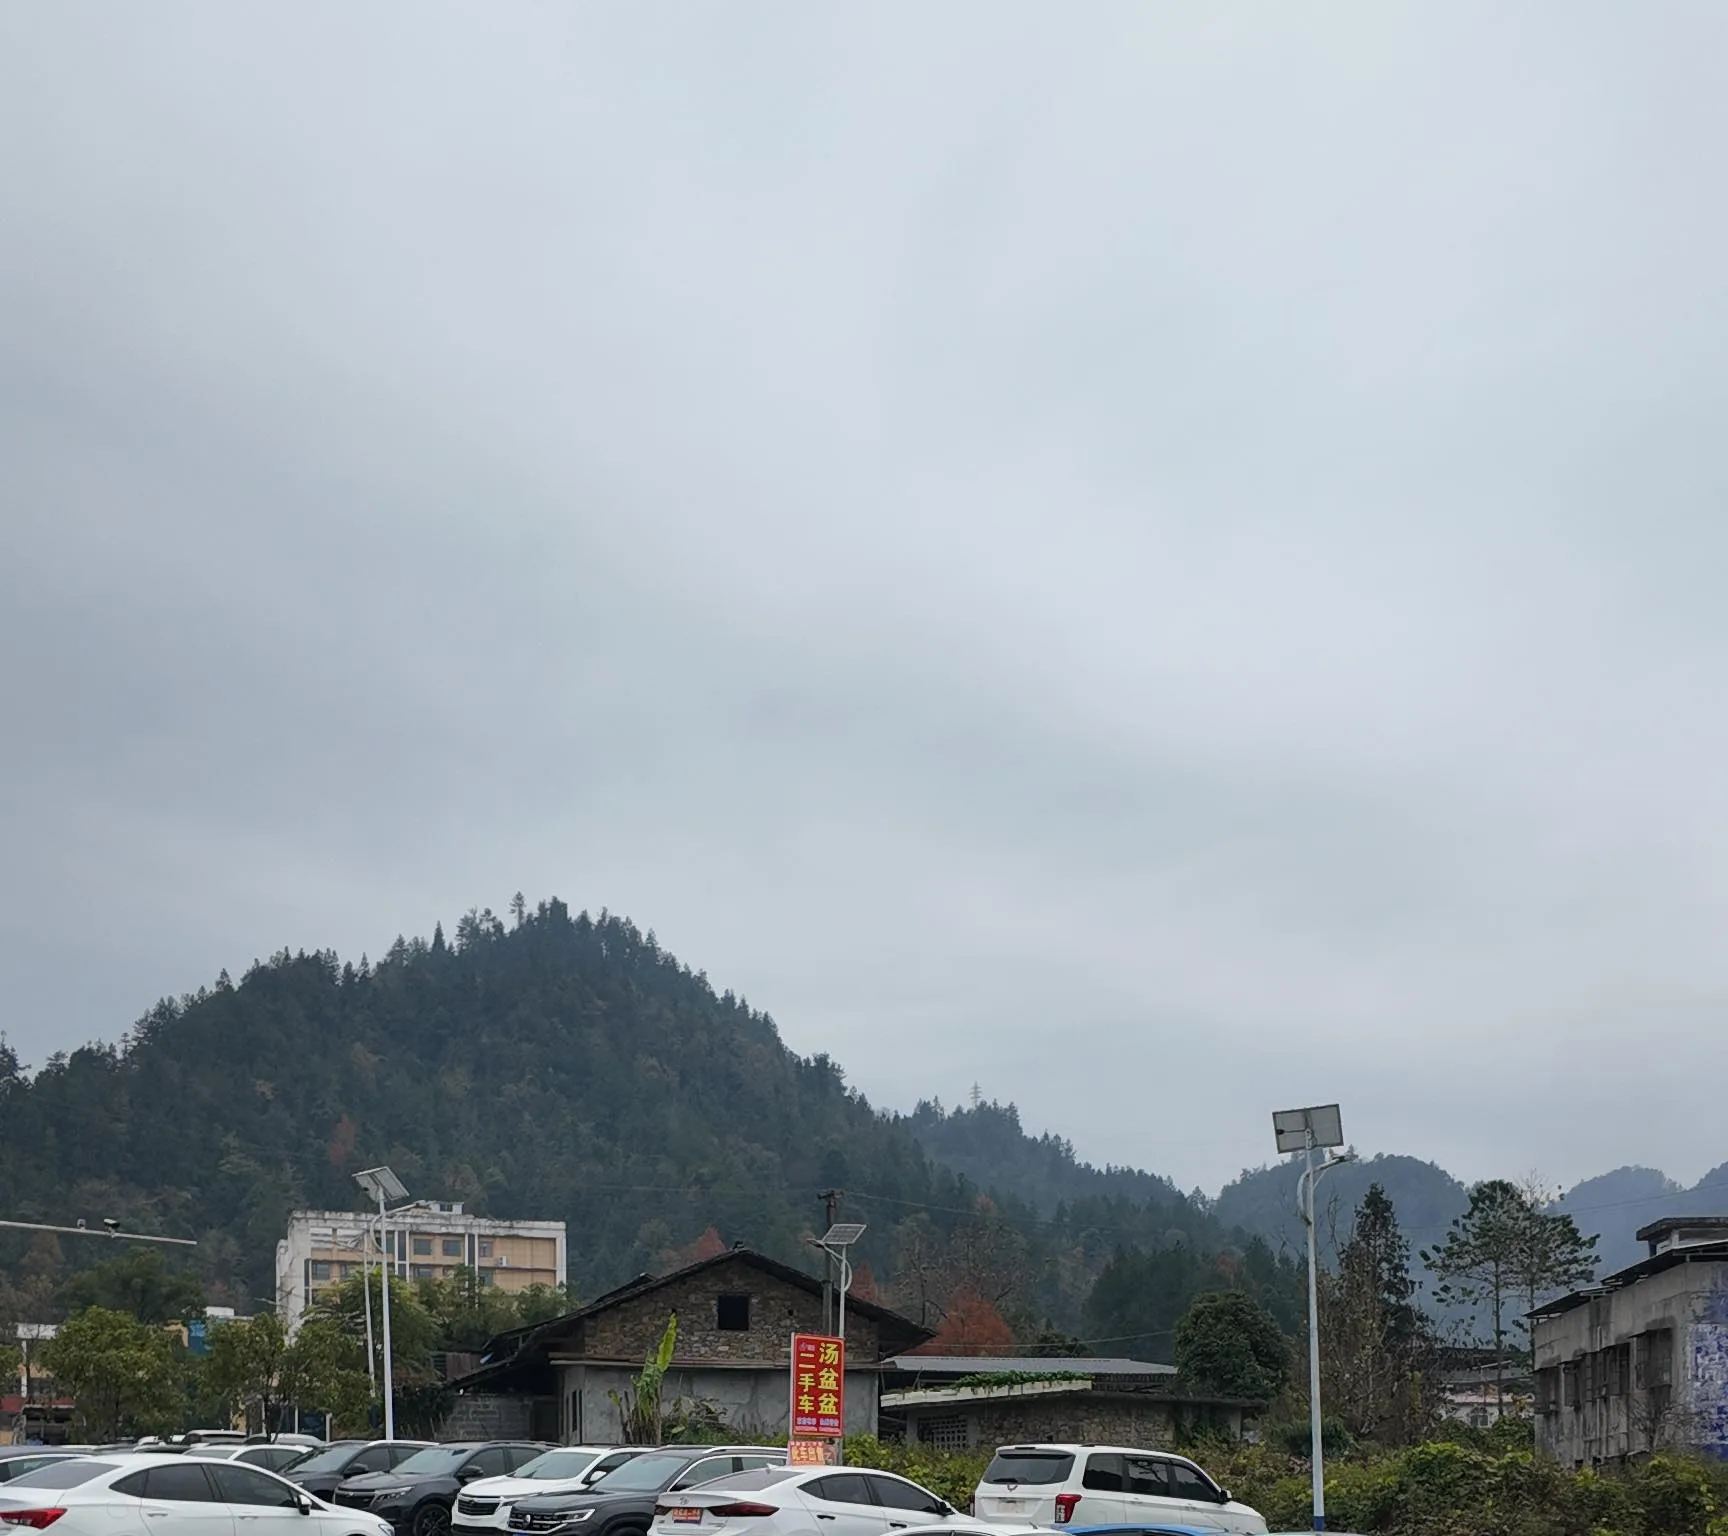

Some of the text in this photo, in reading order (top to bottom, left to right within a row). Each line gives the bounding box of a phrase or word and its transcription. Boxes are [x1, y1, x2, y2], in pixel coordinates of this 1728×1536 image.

[798, 1352, 816, 1414] 二手车
[818, 1342, 839, 1415] 汤盆盆
